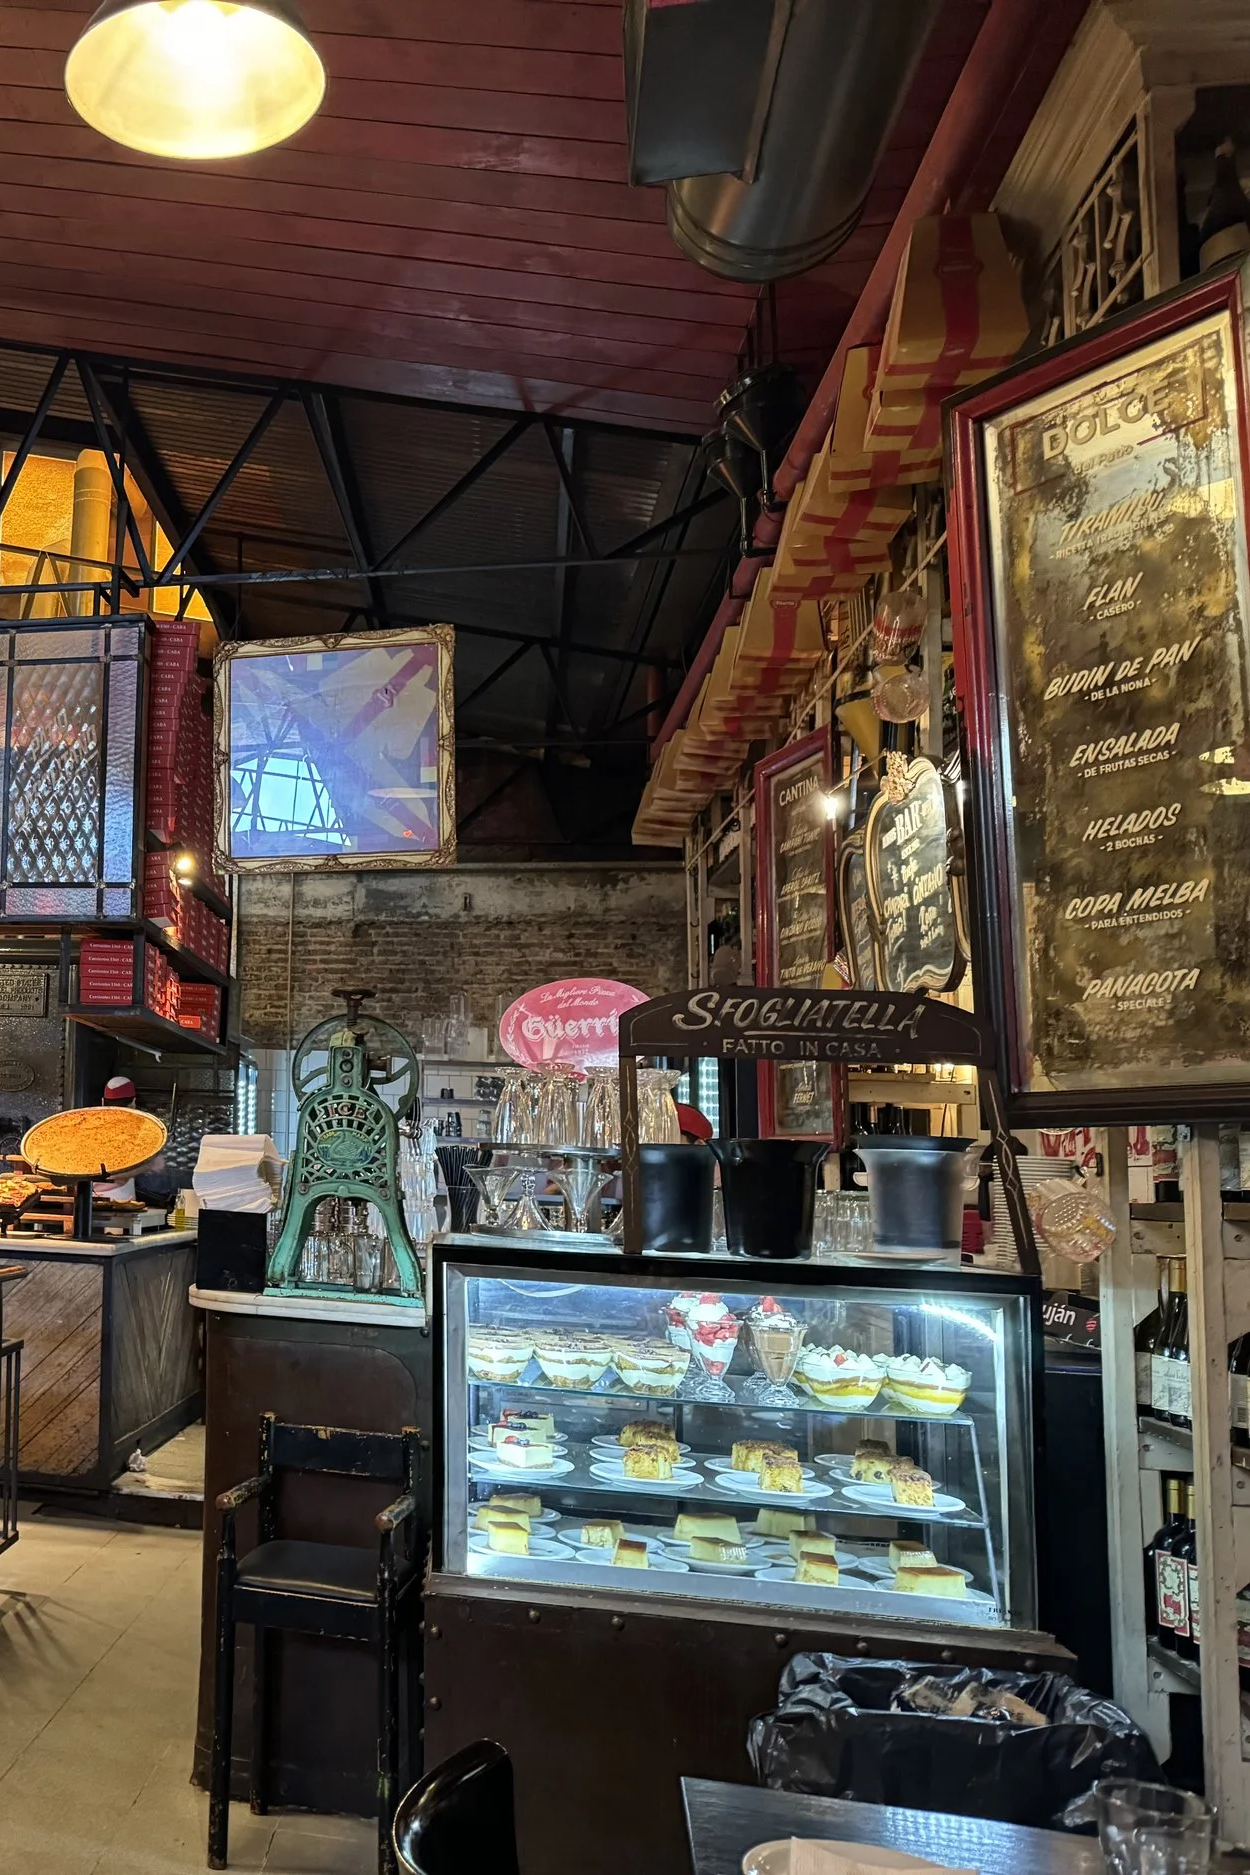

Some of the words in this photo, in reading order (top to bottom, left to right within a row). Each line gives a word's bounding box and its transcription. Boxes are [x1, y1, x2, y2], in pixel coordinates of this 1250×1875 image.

[1042, 380, 1170, 461] DOLCE
[1056, 539, 1093, 559] RICETTA
[1083, 572, 1143, 611] FLAN
[1096, 601, 1135, 620] CASERO
[1043, 661, 1115, 701] BUDIN
[1114, 657, 1144, 681] DE
[1145, 633, 1203, 674] PAN
[1090, 689, 1105, 702] DE
[1106, 685, 1119, 697] LA
[1120, 678, 1152, 693] NONA
[1069, 722, 1181, 768] ENSALADA
[1084, 767, 1097, 778] DE
[1099, 757, 1137, 775] FRUTAS
[1137, 750, 1170, 766] SECAS
[779, 775, 820, 807] CANTINA
[894, 801, 923, 846] BAR
[1082, 803, 1182, 842] HELADOS
[1106, 842, 1114, 852] 2
[1115, 834, 1156, 850] BOCHAS
[1064, 892, 1123, 920] COPA
[1125, 878, 1210, 911] MELBA
[1091, 917, 1118, 930] PARA
[1119, 908, 1184, 926] ENTENDIDOS
[1082, 967, 1201, 1001] PANACOTA
[672, 991, 926, 1039] SFOGLIATELLA
[1117, 997, 1165, 1011] SPECIALE
[722, 1038, 786, 1056] FATTO
[800, 1040, 819, 1056] IN
[825, 1041, 882, 1058] CASA
[327, 1102, 366, 1118] ICE
[1042, 1303, 1077, 1326] uján
